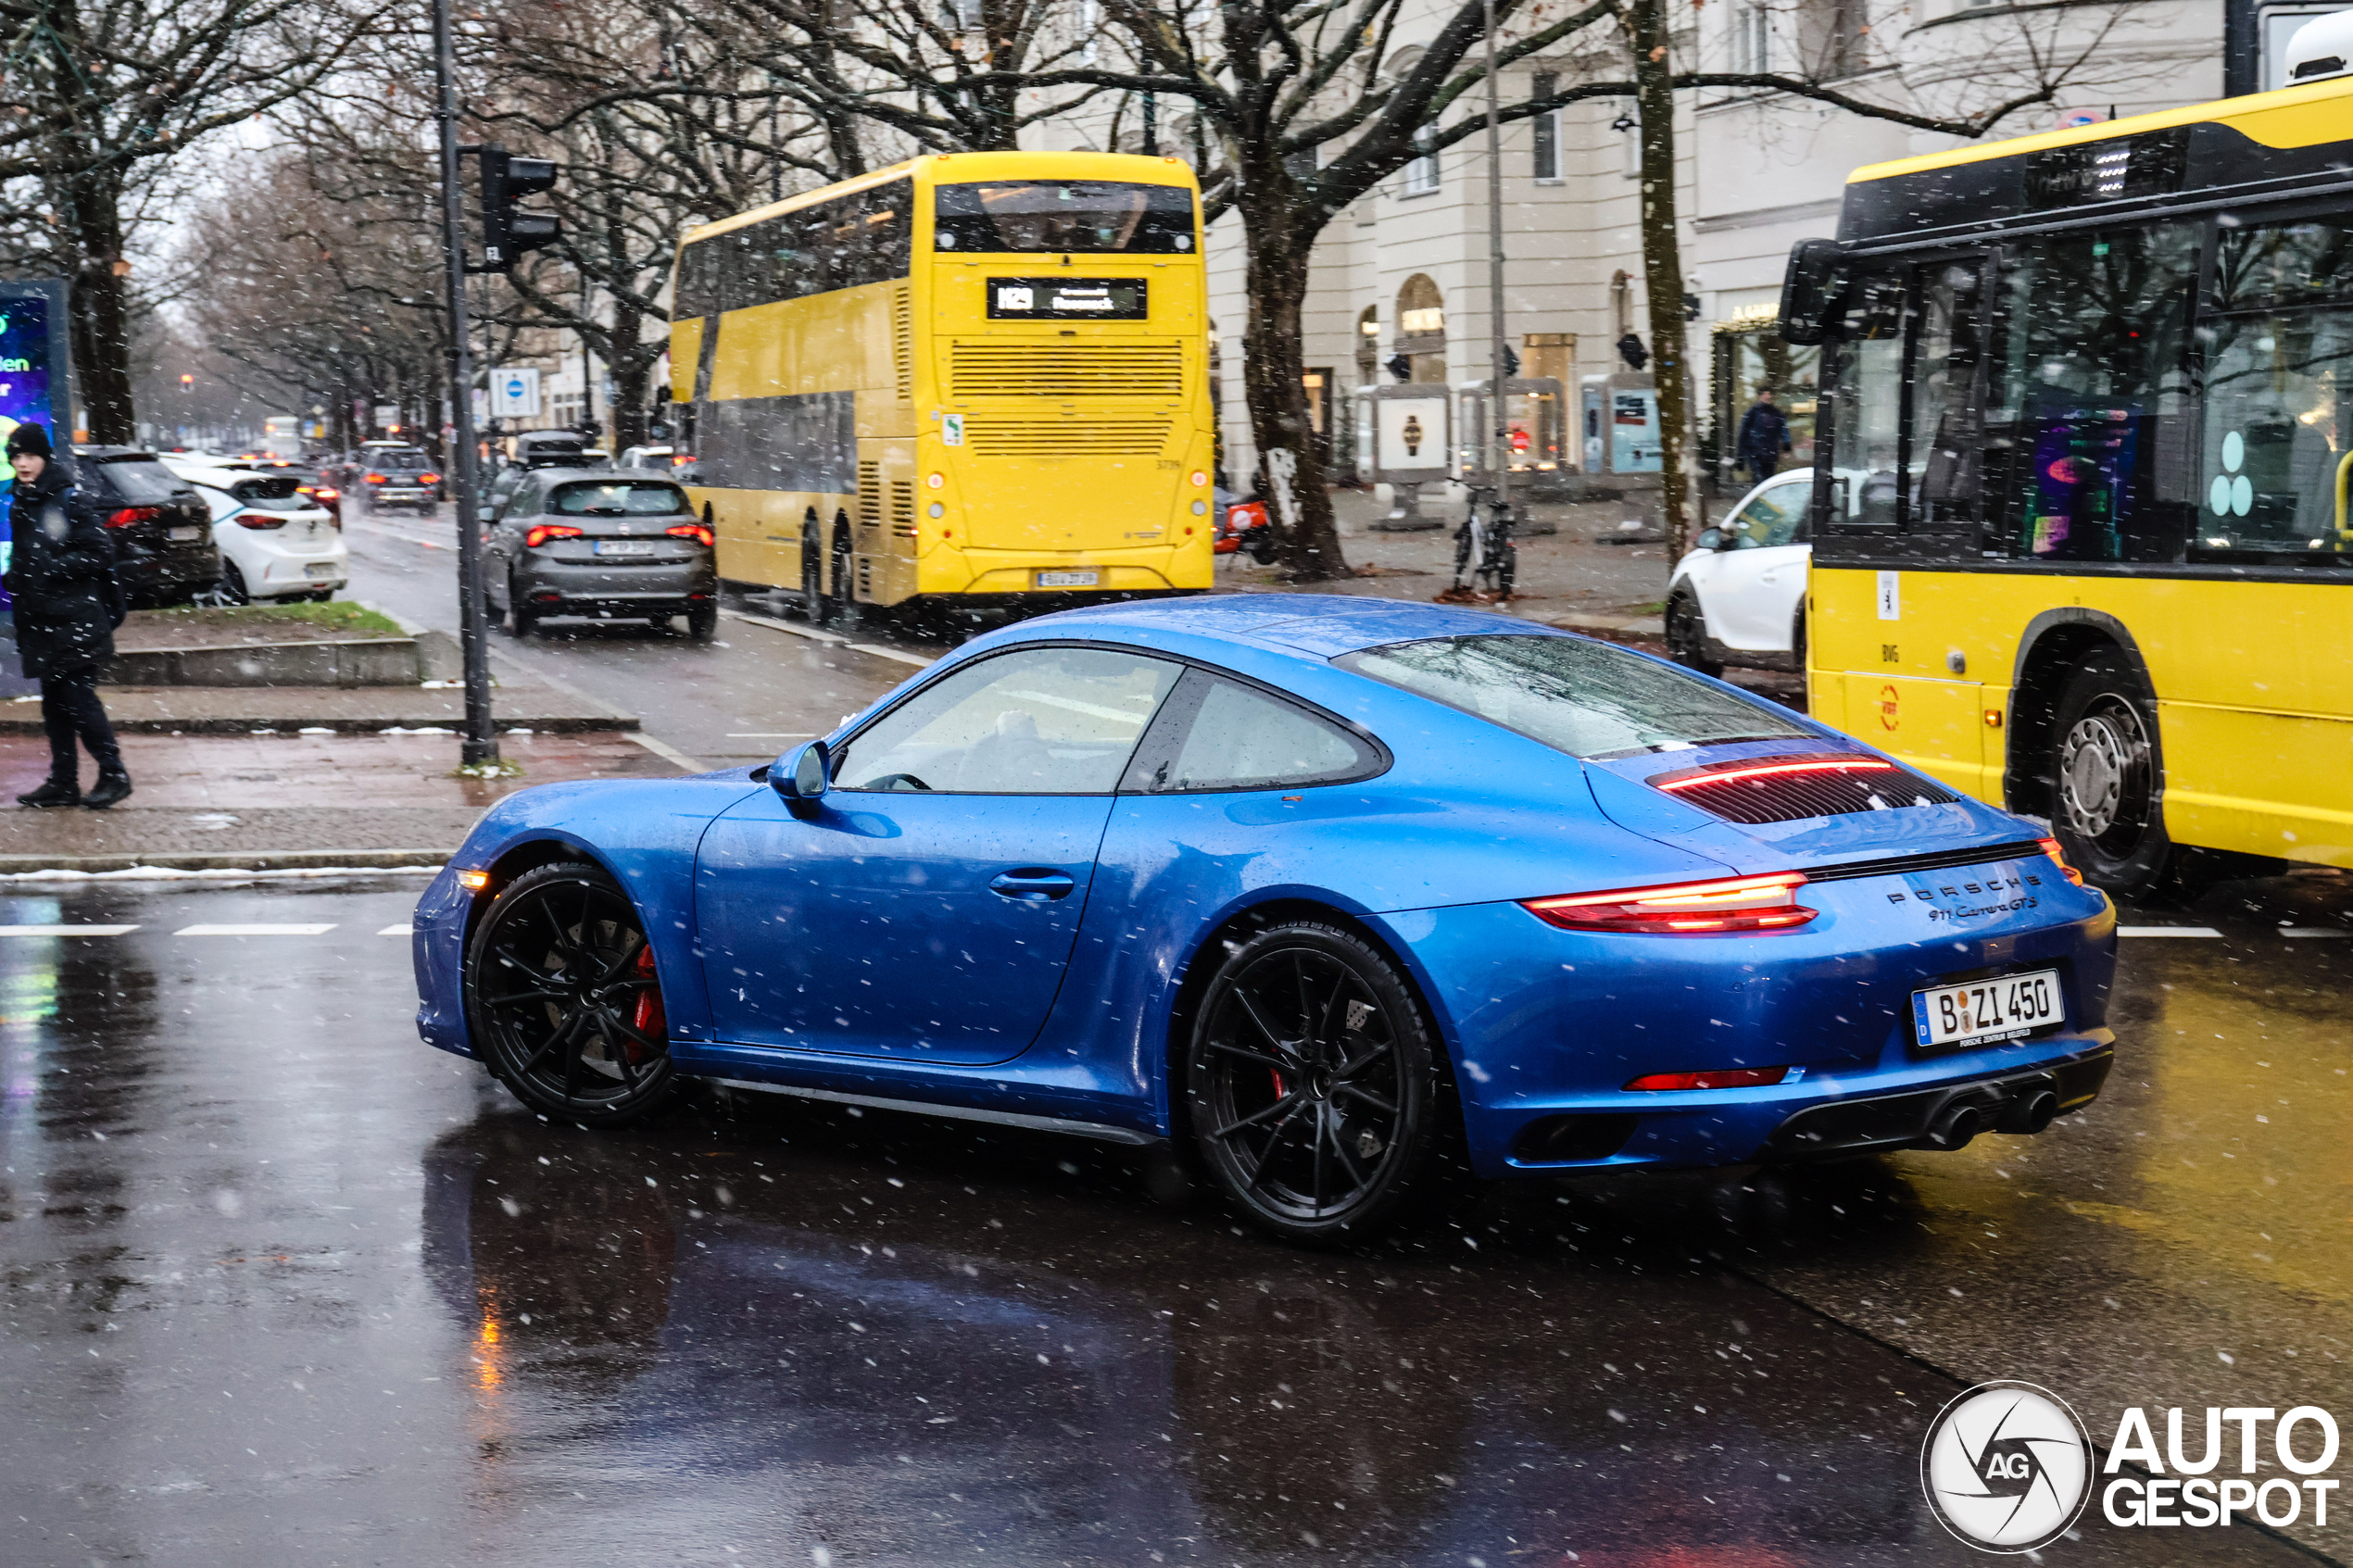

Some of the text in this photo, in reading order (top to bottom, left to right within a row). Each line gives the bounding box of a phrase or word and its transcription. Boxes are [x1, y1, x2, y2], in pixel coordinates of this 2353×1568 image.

[1887, 875, 2041, 904] PORSCHE
[1929, 908, 1953, 921] 911
[2009, 897, 2038, 910] GTS
[1940, 978, 2049, 1035] B ZI 450
[1959, 1036, 1982, 1047] PORSCHE
